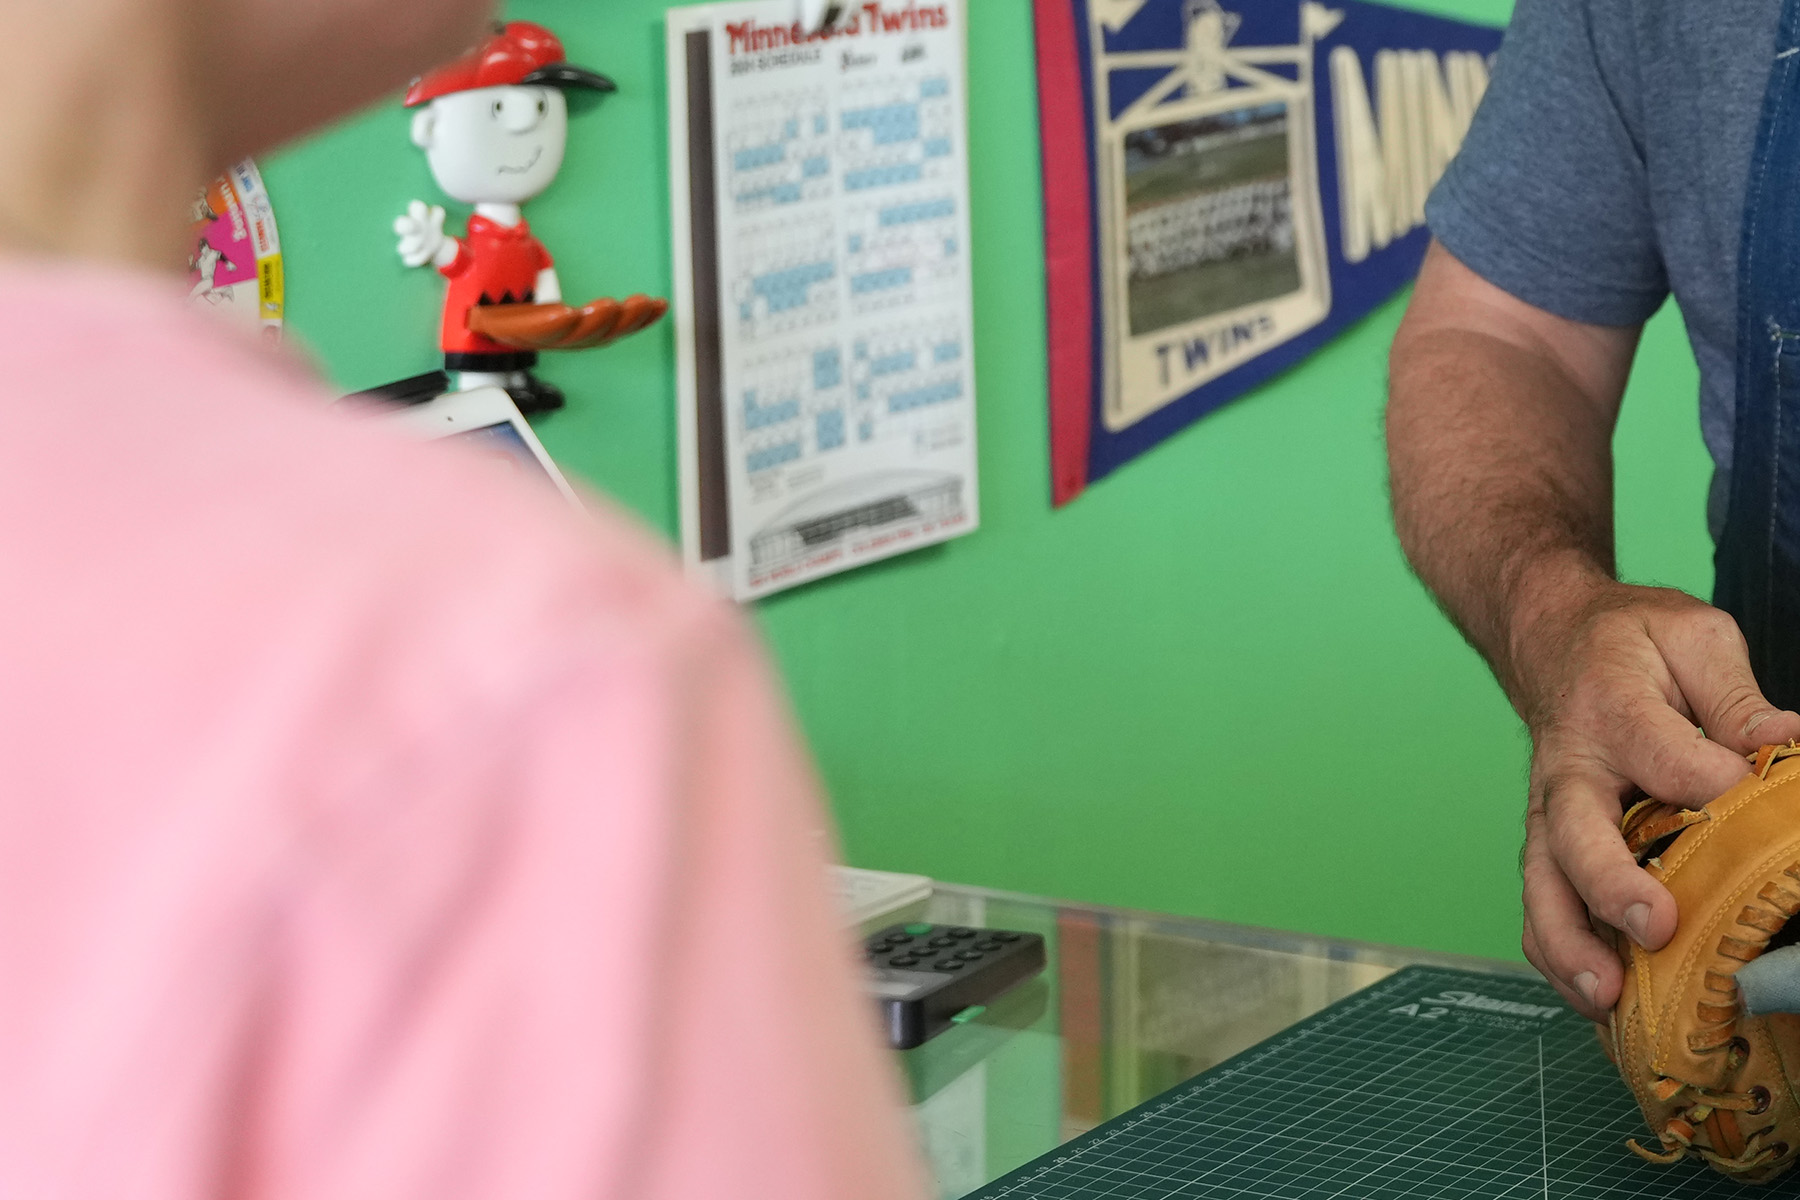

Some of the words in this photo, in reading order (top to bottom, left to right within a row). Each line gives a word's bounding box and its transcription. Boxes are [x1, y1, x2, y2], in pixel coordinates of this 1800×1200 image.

[1329, 45, 1500, 263] MIN
[1153, 313, 1278, 388] TWINS
[1387, 1002, 1450, 1020] A2
